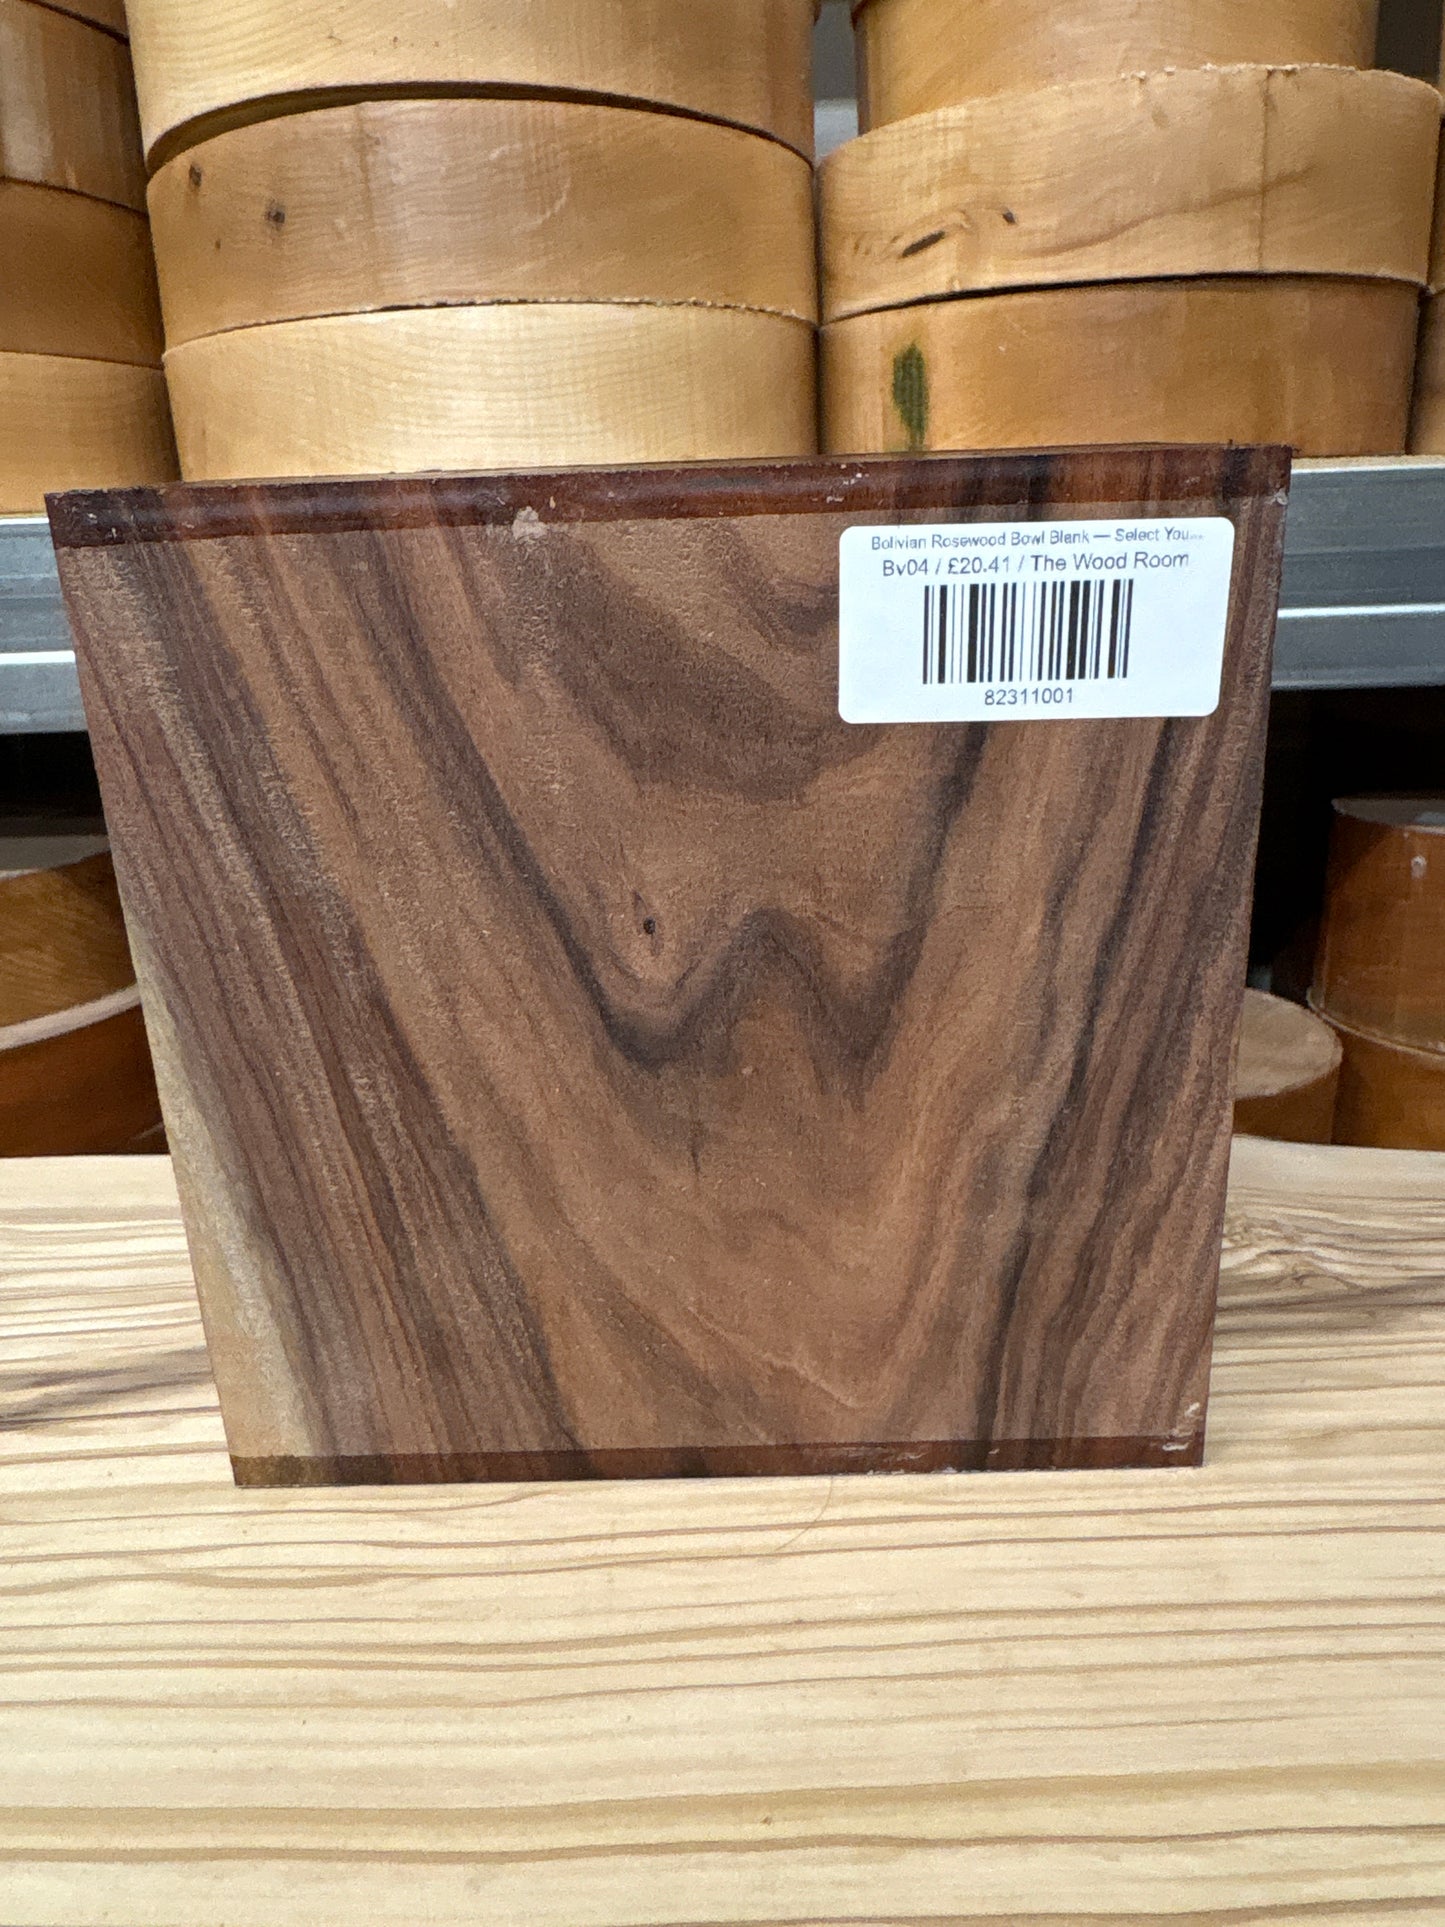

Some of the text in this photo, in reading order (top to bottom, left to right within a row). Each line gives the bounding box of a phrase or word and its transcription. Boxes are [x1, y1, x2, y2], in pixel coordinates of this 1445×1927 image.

[871, 535, 927, 550] Bolivian
[931, 532, 1006, 548] Rosewood
[1010, 530, 1045, 546] Bowl
[1050, 529, 1090, 544] Blank
[1114, 528, 1160, 542] Select
[882, 558, 928, 576] Bv04
[947, 556, 1010, 575] £20.41
[1030, 554, 1067, 572] The
[1073, 552, 1128, 570] Wood
[1133, 551, 1189, 568] Room
[984, 687, 1073, 706] 82311001
